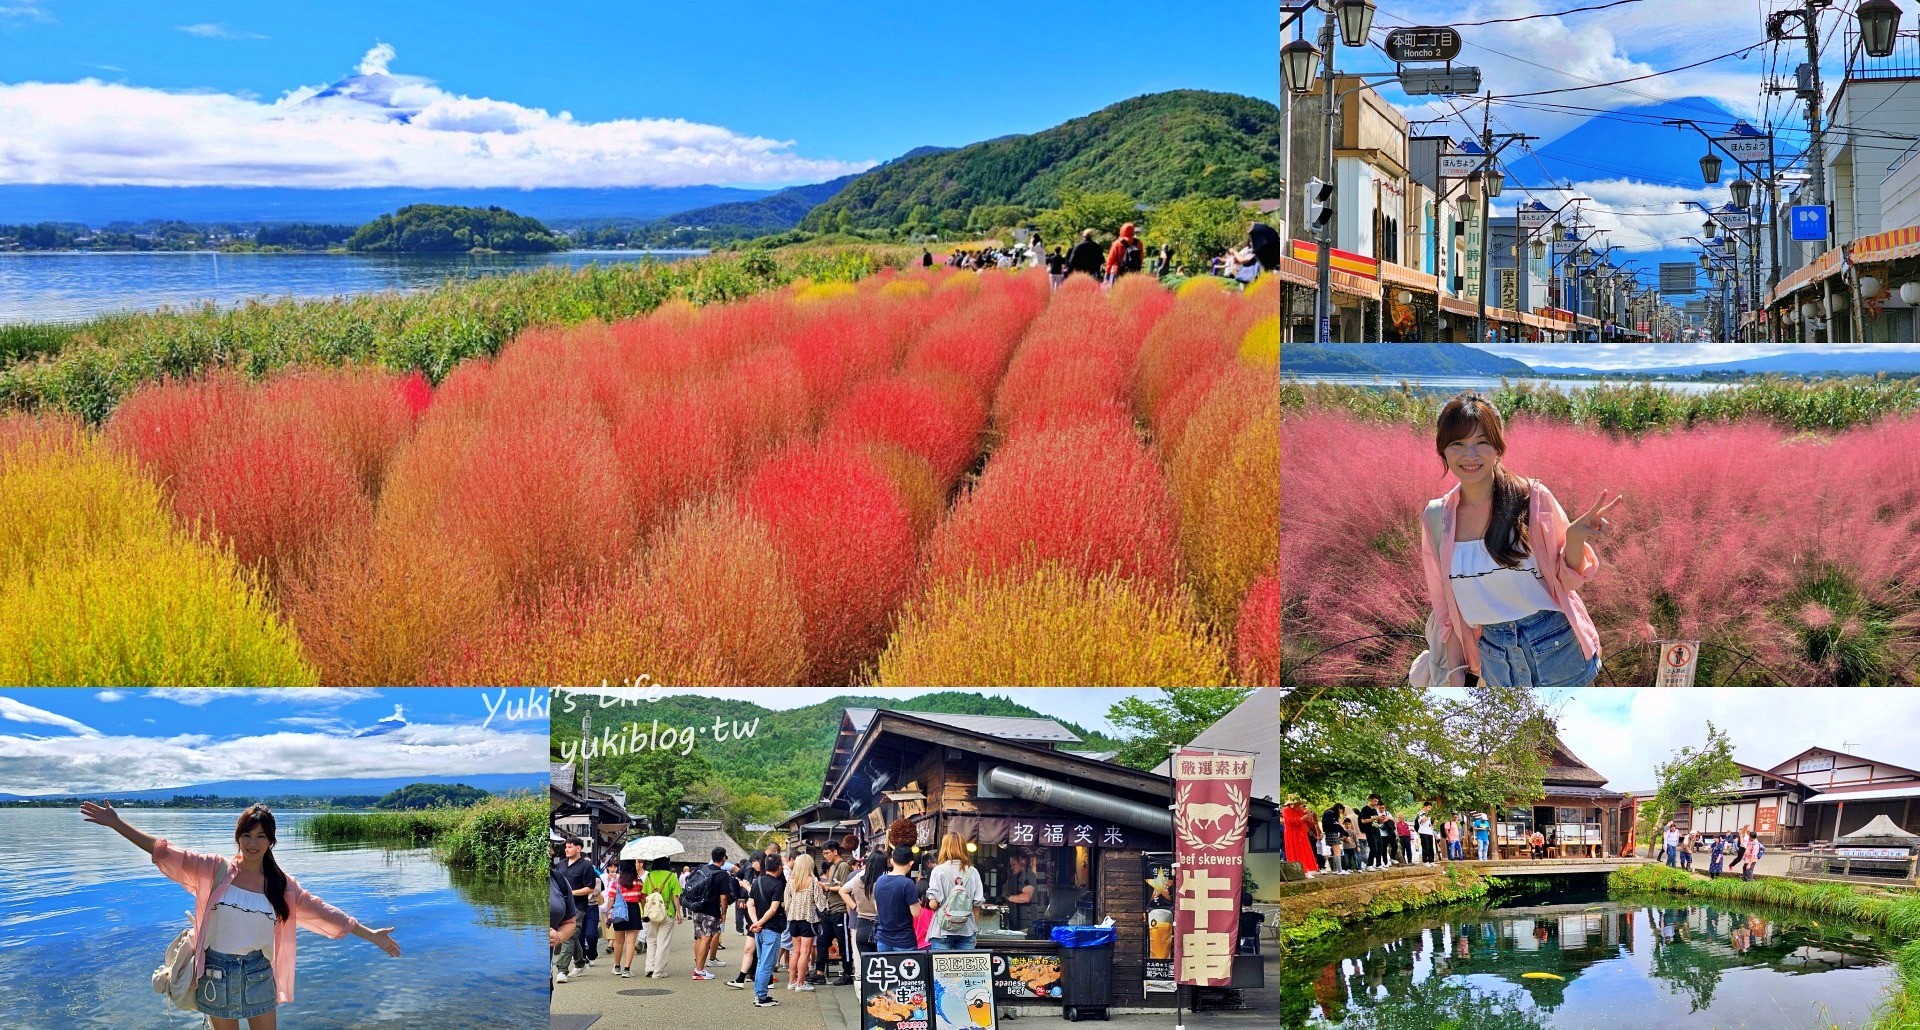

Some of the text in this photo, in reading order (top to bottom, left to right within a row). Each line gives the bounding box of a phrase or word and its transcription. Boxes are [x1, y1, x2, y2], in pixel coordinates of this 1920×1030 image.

[1393, 33, 1452, 48] 本町二丁目
[1404, 48, 1441, 57] Honcho 2
[1731, 141, 1766, 151] ほんちょう
[1443, 159, 1475, 168] ほんちょう
[1181, 760, 1248, 776] 厳選素材
[1013, 822, 1125, 845] 招福笑来
[1198, 852, 1243, 865] skewers
[1178, 868, 1235, 987] 牛串
[935, 957, 990, 973] BEER
[867, 957, 899, 992] 牛
[994, 980, 1026, 988] apanese
[1007, 986, 1026, 995] Beef
[895, 986, 912, 1005] 串
